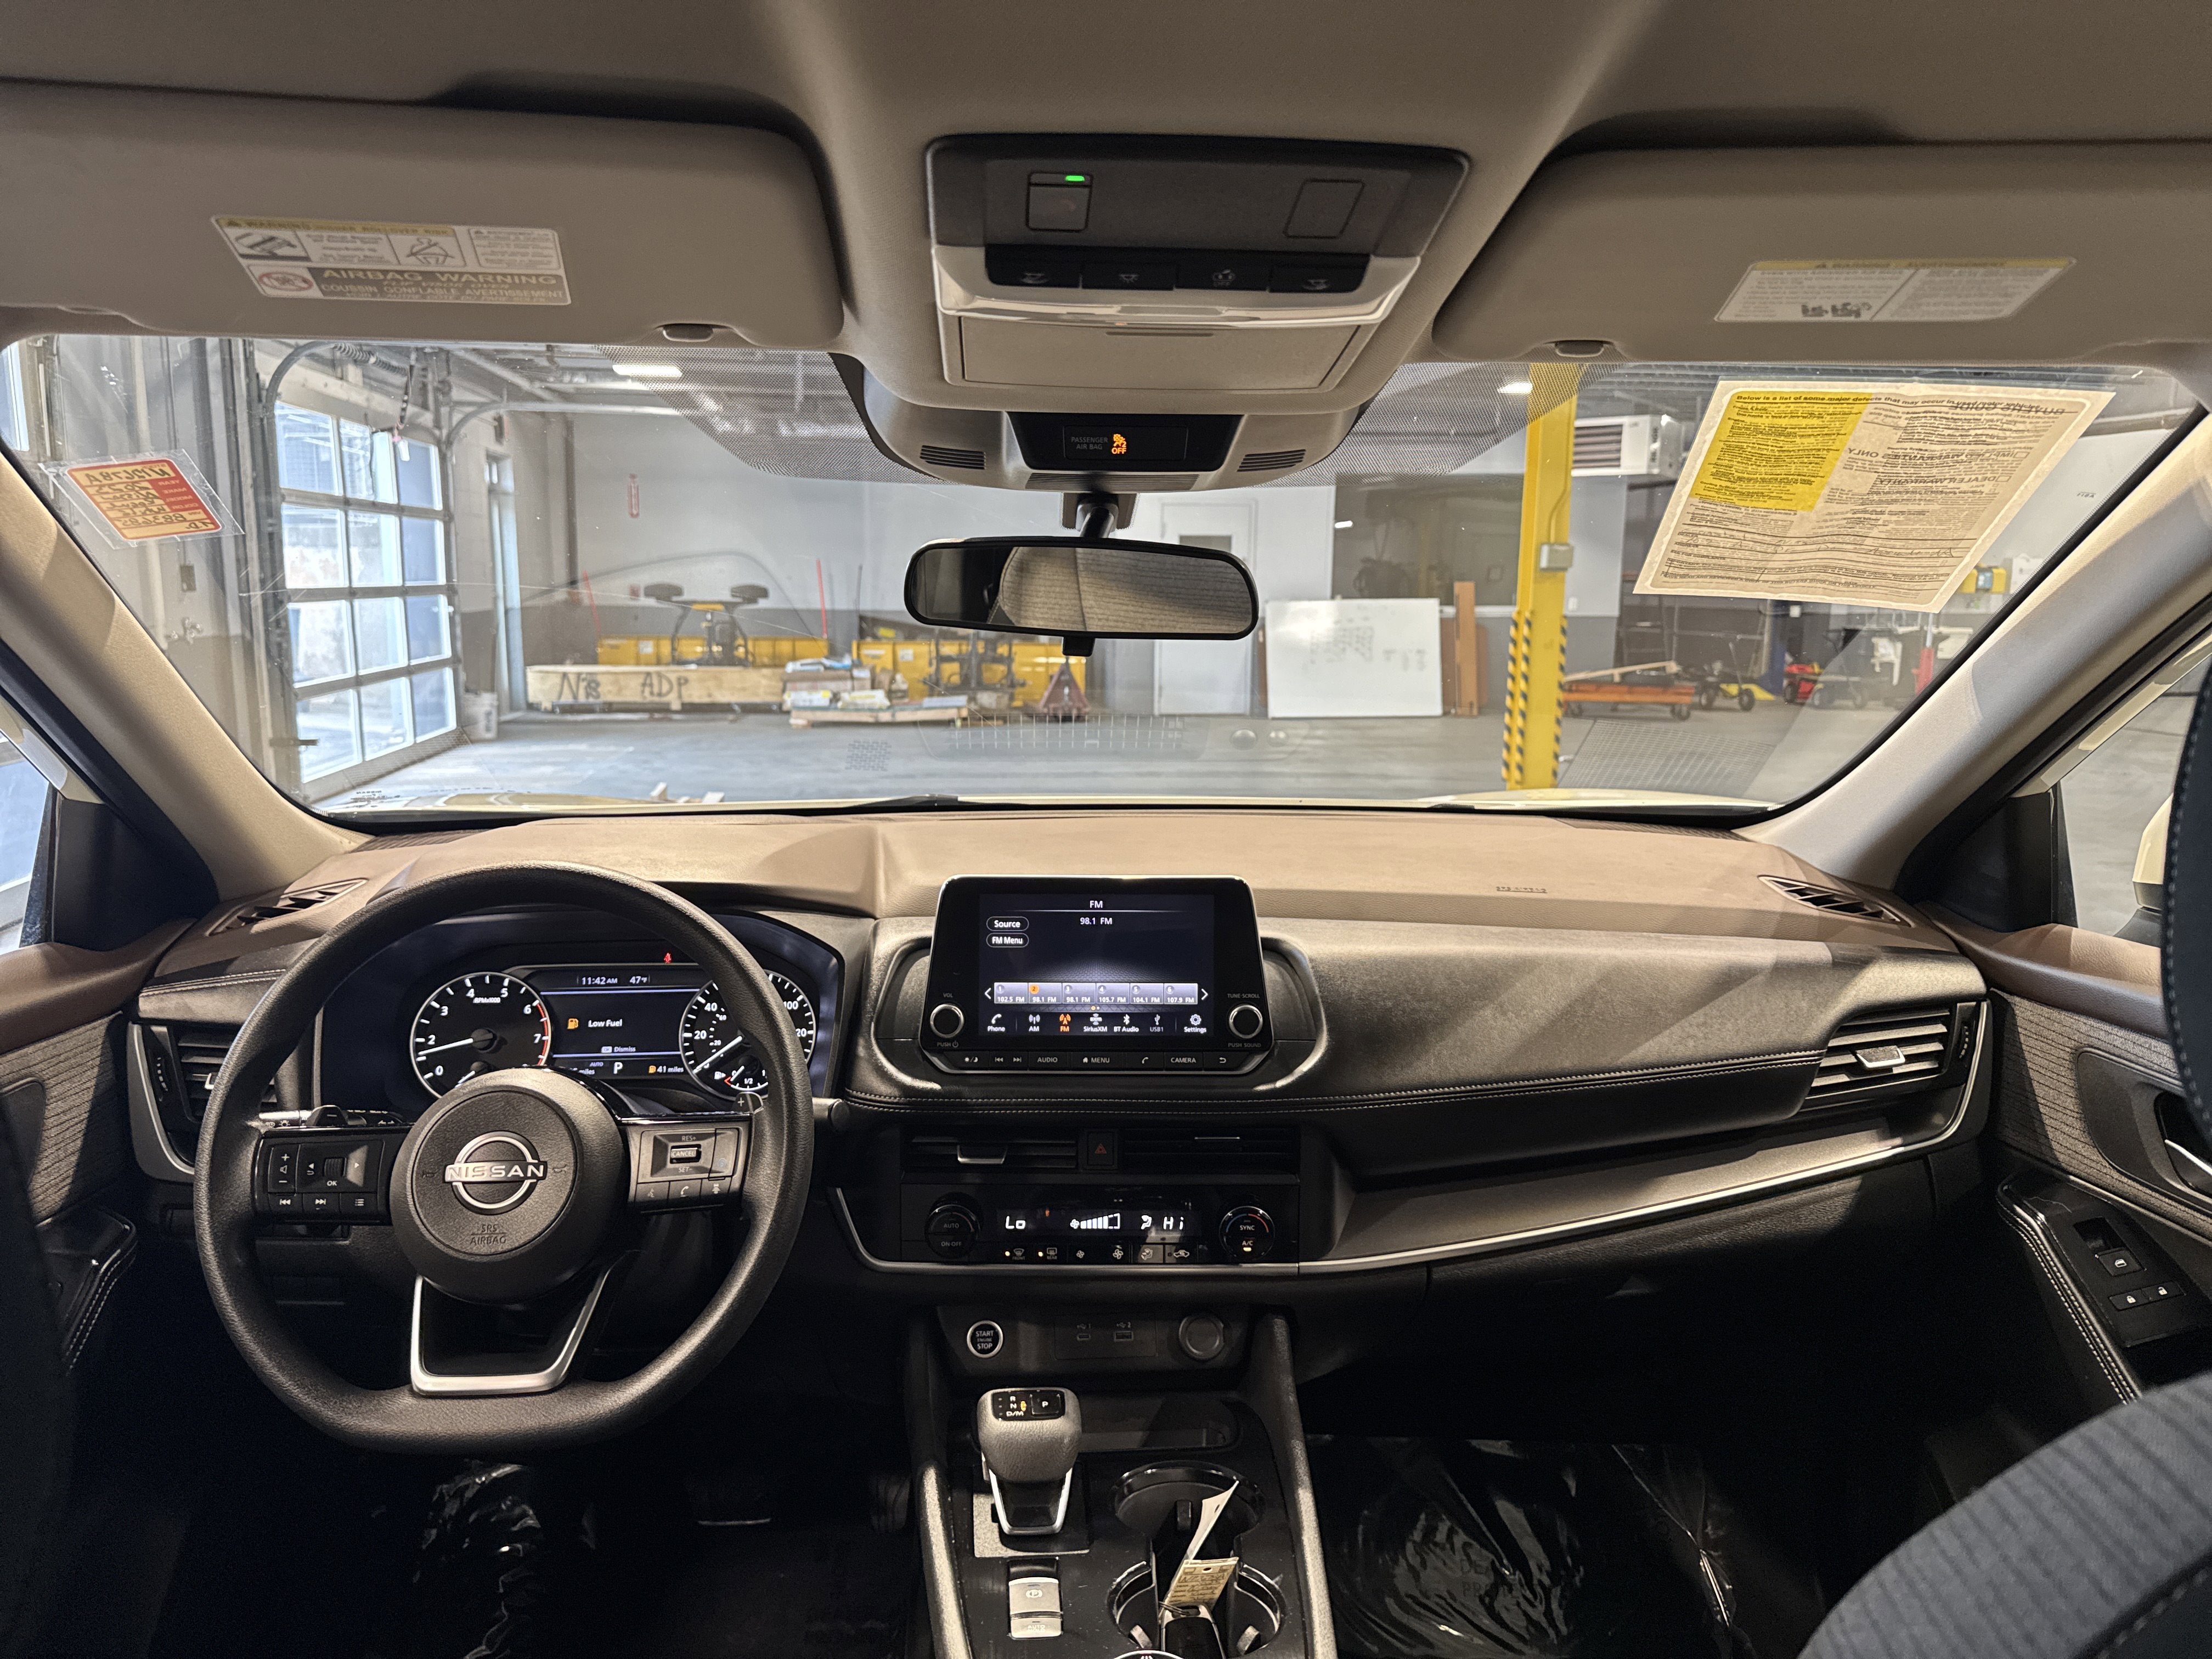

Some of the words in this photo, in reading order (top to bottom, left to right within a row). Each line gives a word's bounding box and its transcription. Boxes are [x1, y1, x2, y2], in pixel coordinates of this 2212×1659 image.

[323, 269, 423, 281] AIRBAG
[435, 273, 556, 285] WARNING
[640, 672, 689, 700] ADP
[1090, 900, 1103, 909] FM
[994, 919, 1021, 928] Source
[1080, 917, 1096, 925] 98.1
[1003, 936, 1023, 944] Menu
[629, 976, 647, 984] 47°F
[466, 988, 475, 998] 4
[500, 988, 509, 997] 5
[440, 1006, 449, 1016] 3
[523, 1005, 532, 1014] 6
[704, 1002, 717, 1012] 40
[605, 1019, 623, 1027] Fuel
[427, 1035, 436, 1045] 2
[533, 1033, 542, 1043] 7
[694, 1030, 707, 1040] 20
[435, 1065, 444, 1076] 0
[613, 1062, 623, 1074] P
[447, 1165, 544, 1180] NISSAN
[1005, 1215, 1026, 1229] Lo
[1163, 1216, 1184, 1229] Hi
[481, 1223, 498, 1233] SRS
[470, 1236, 506, 1245] AIRBAG
